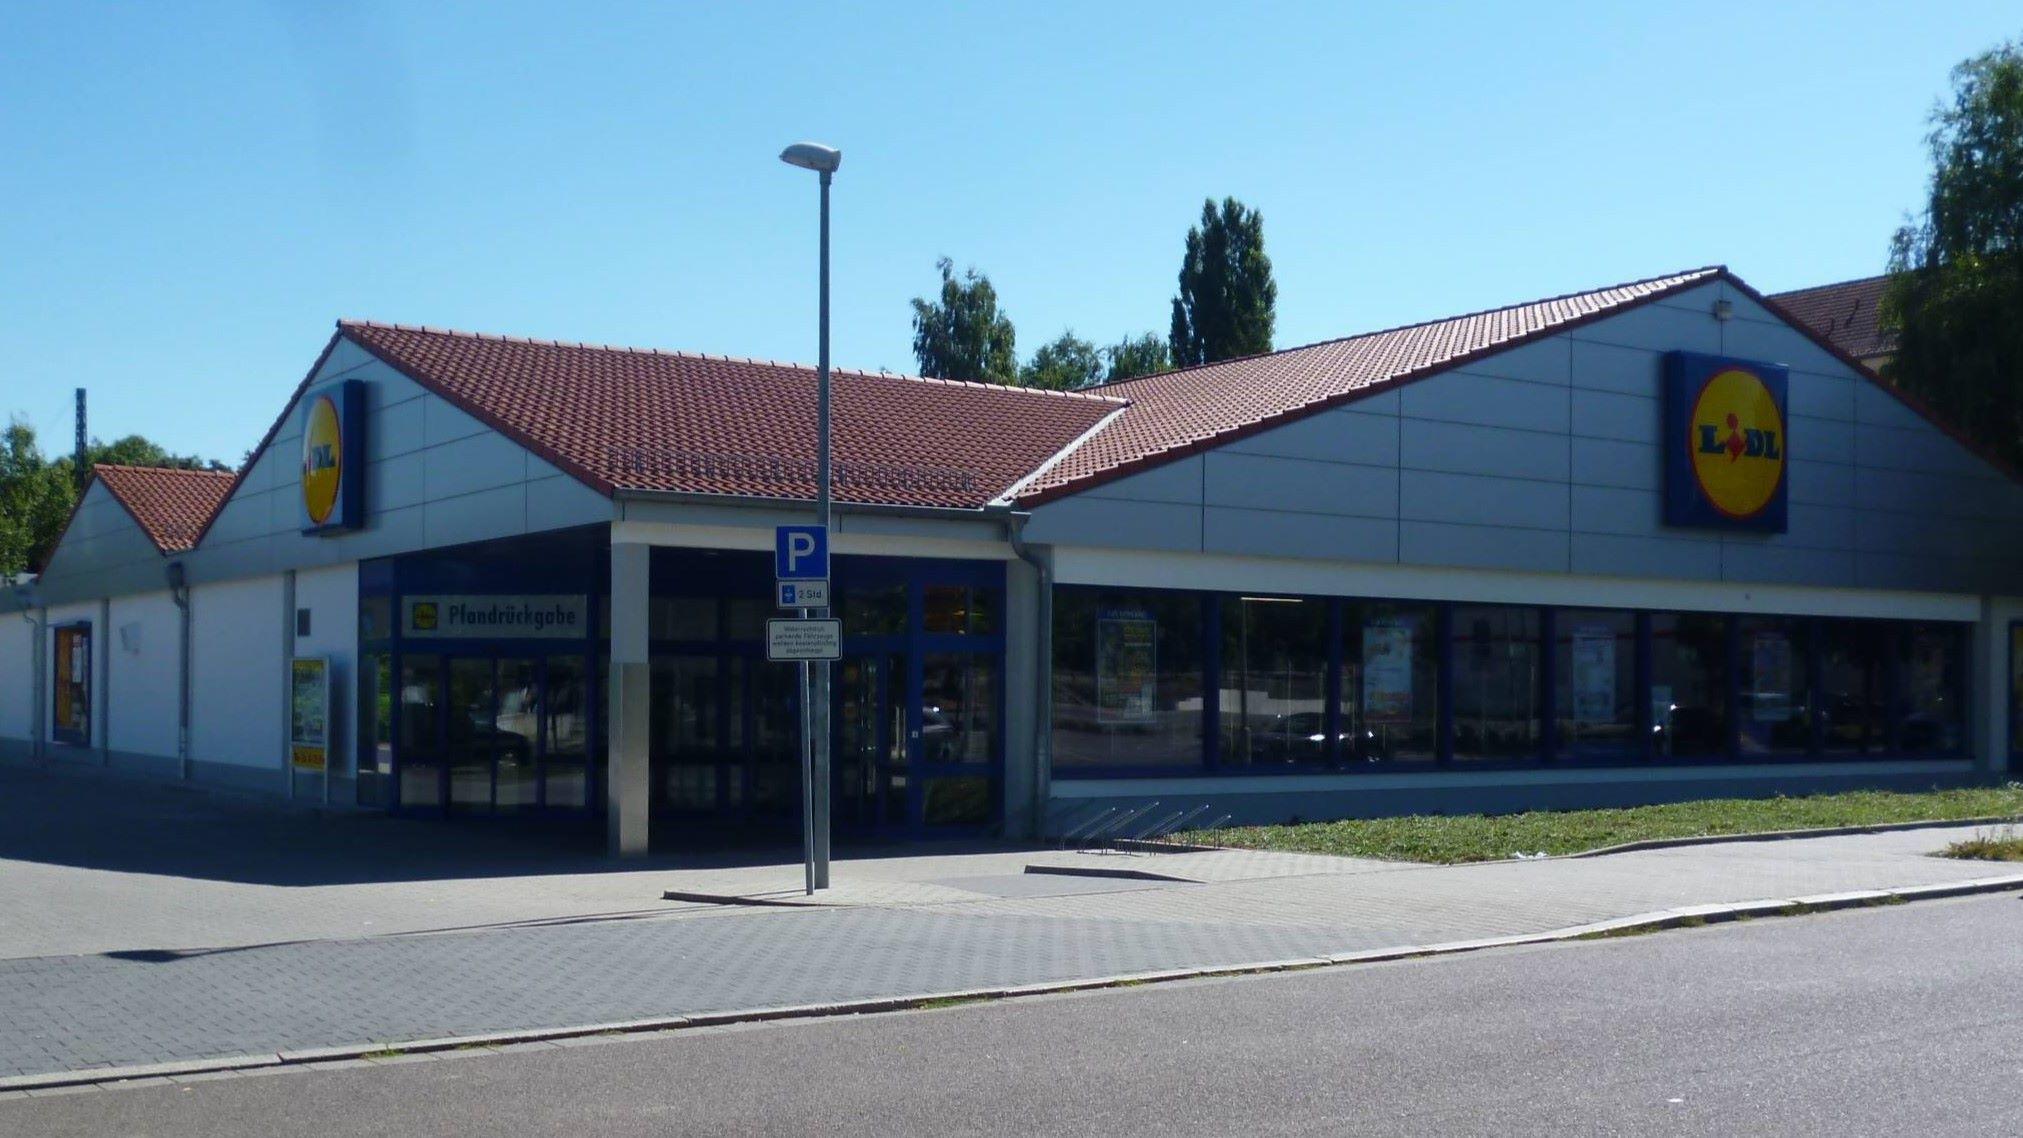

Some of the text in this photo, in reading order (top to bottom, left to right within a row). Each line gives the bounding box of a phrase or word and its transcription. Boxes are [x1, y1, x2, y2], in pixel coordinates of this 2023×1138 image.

[788, 532, 815, 572] P
[798, 590, 804, 600] 2
[450, 603, 577, 631] Pfandrückgabe
